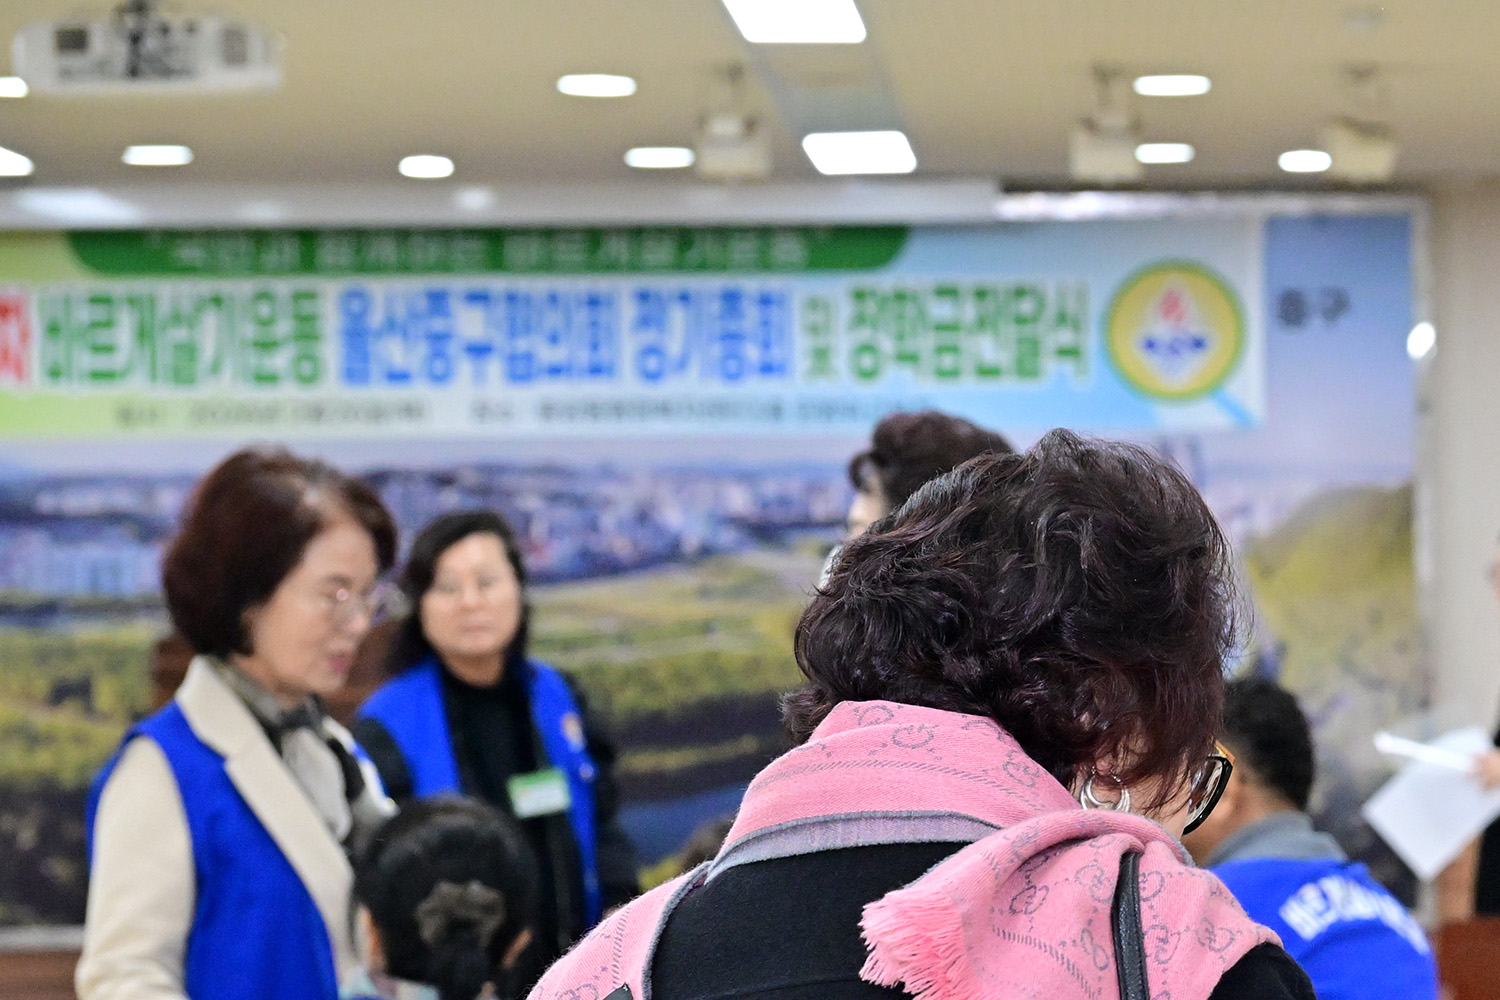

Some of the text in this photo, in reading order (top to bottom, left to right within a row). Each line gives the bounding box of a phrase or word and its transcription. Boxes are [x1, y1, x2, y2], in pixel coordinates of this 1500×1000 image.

[39, 289, 322, 385] 바르게살기운동
[340, 287, 619, 386] 울산중구협의회
[847, 284, 1090, 381] 장학금전달식
